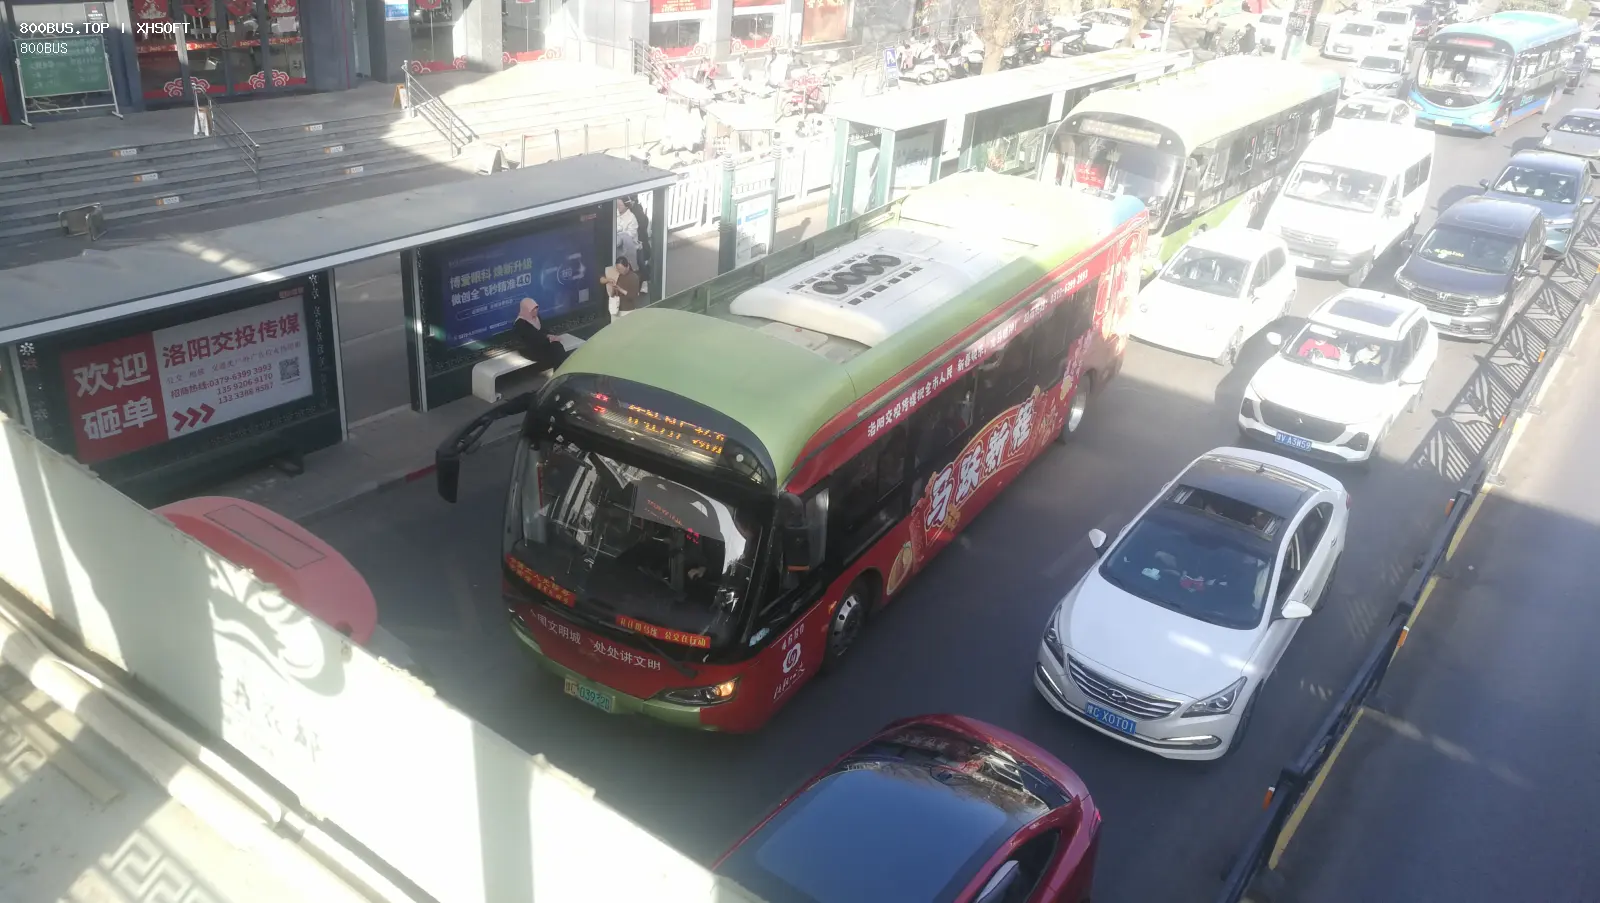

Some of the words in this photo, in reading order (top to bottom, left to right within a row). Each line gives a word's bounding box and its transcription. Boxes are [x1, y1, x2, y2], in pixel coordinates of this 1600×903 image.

[162, 312, 301, 368] 洛阳交投传媒
[73, 351, 151, 399] 欢迎
[81, 395, 158, 440] 砸单
[867, 364, 954, 438] 洛阳交投传媒祝全市人民
[927, 399, 1035, 526] 马跃新程
[593, 640, 661, 672] 处处讲文明
[663, 630, 707, 648] 公交在行动
